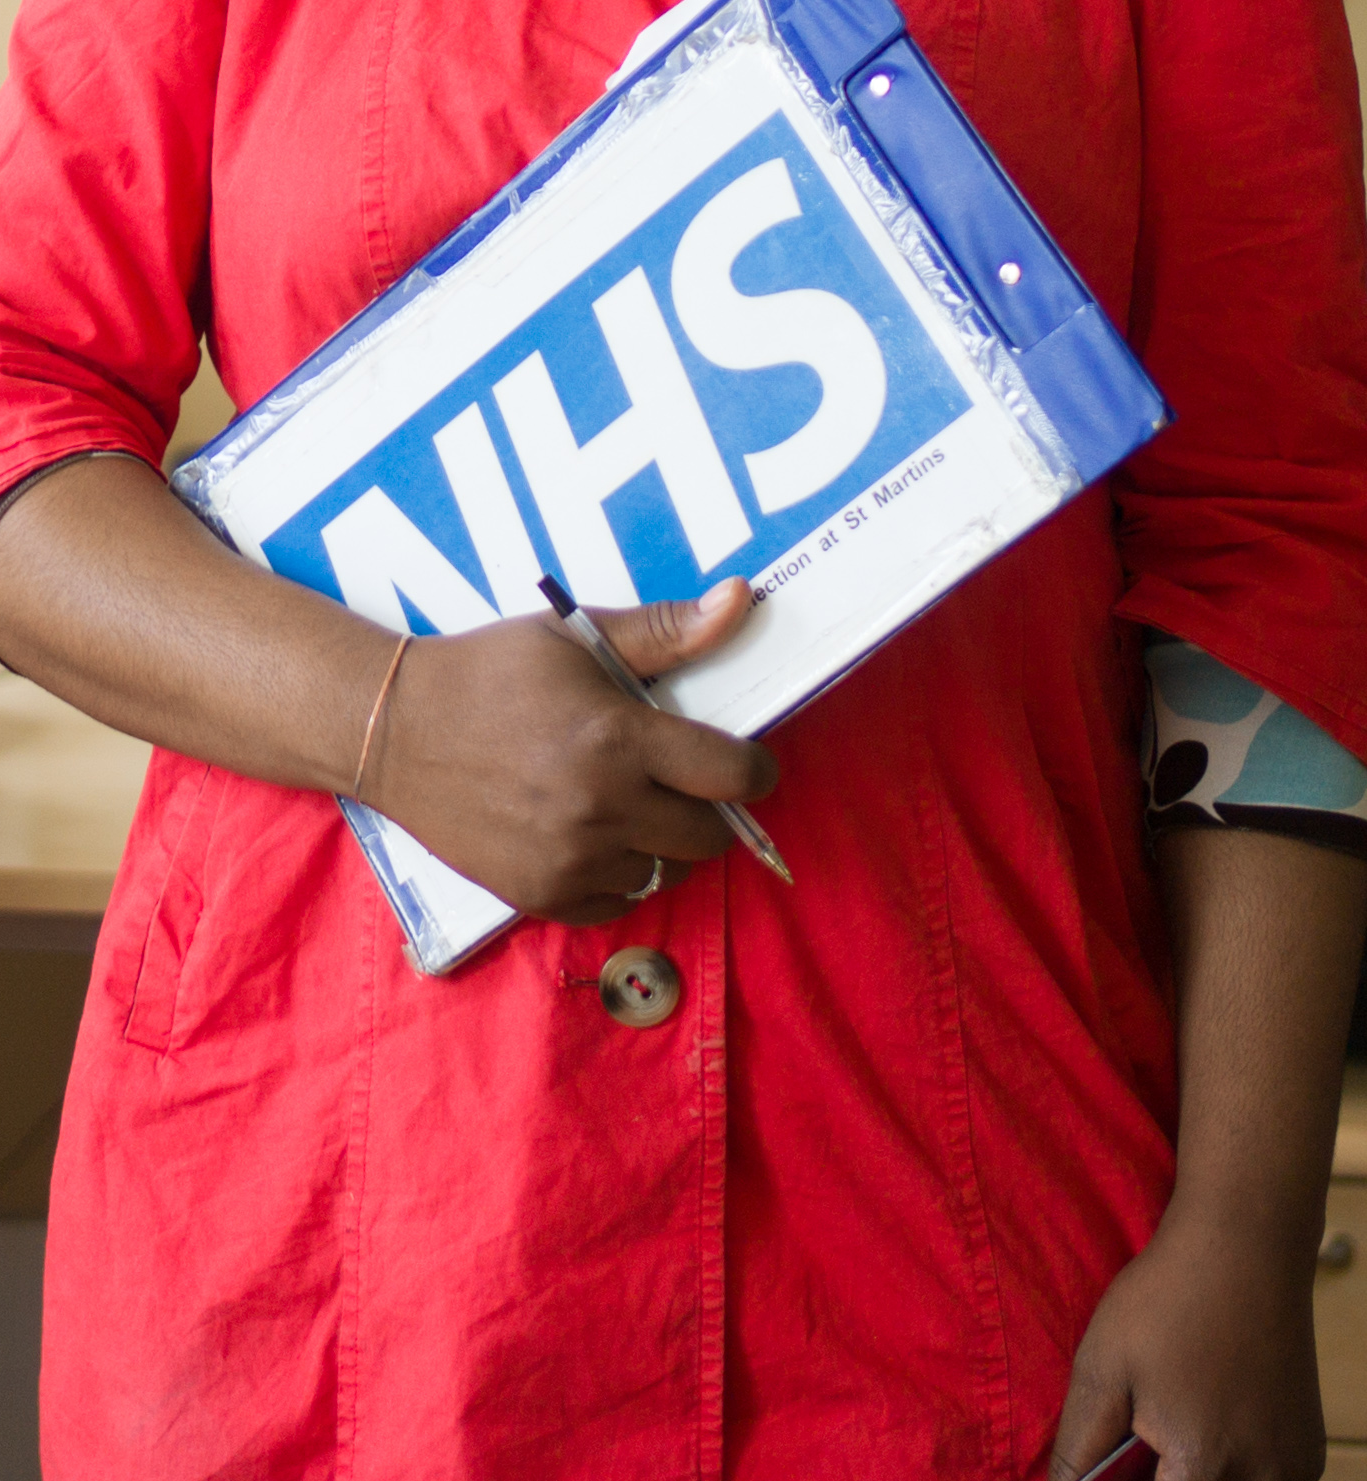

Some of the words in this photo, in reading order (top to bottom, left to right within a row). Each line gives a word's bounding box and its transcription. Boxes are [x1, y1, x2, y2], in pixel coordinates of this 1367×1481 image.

[321, 157, 887, 634] NHS
[817, 528, 840, 552] at
[843, 505, 869, 530] St
[871, 447, 946, 509] Martins
